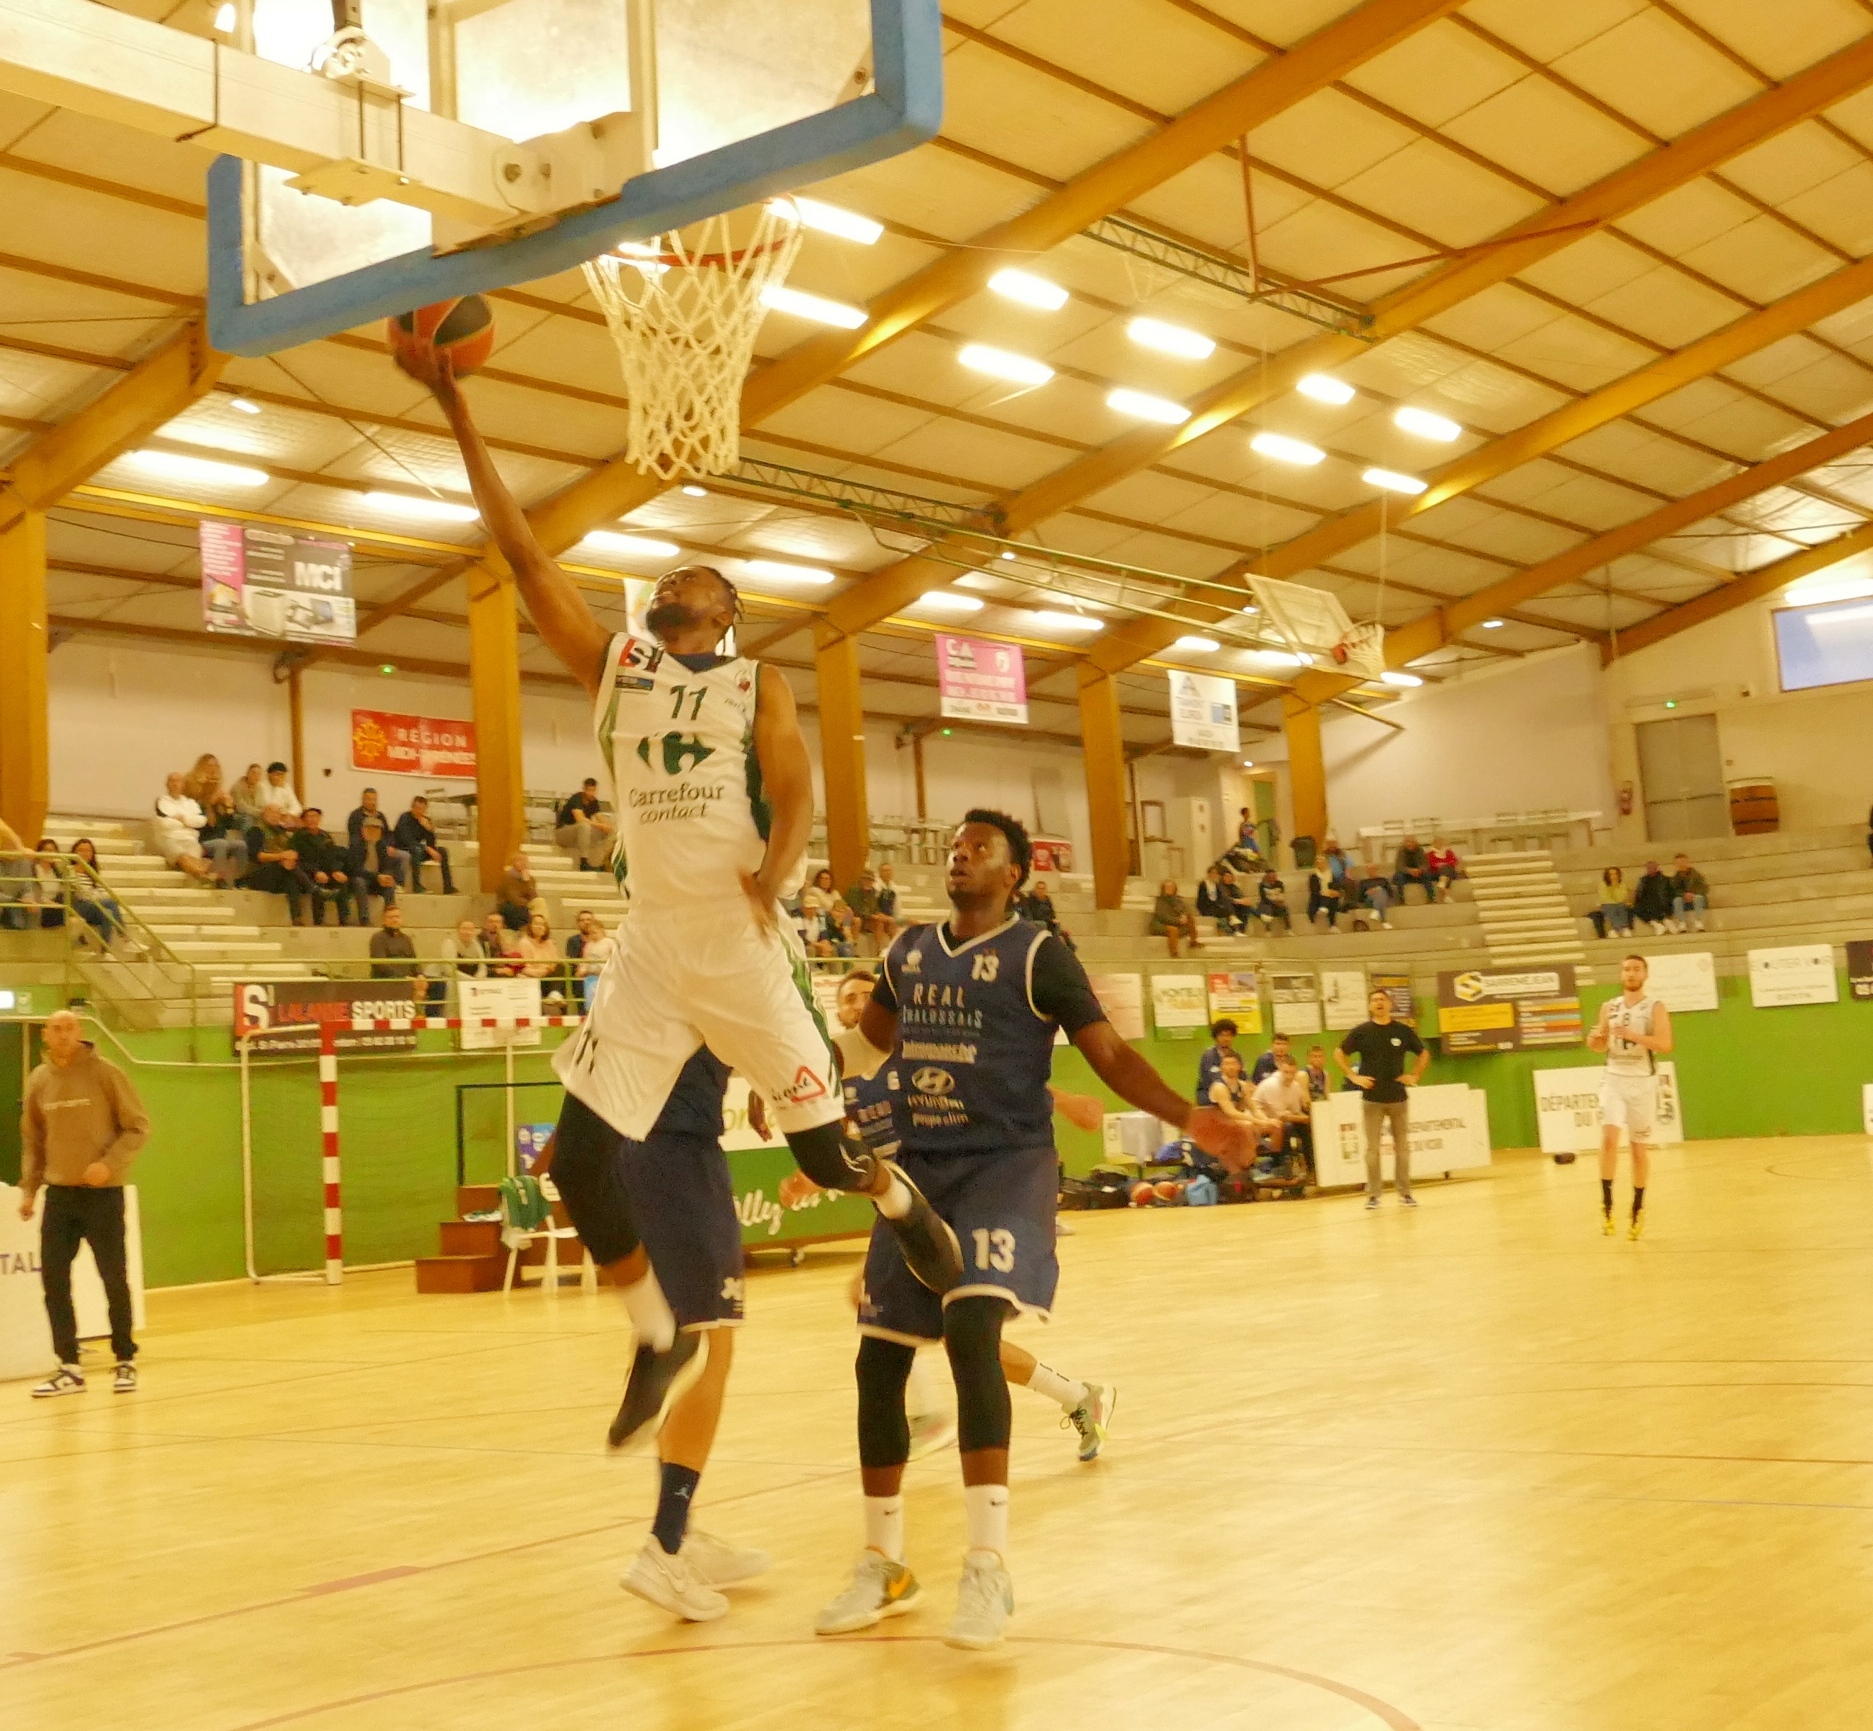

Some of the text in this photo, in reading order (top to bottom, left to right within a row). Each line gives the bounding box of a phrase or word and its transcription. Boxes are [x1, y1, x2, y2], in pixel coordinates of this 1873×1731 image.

[669, 684, 709, 721] 11
[629, 782, 725, 808] Carrefour
[640, 802, 708, 825] contact
[971, 953, 1000, 982] 13
[913, 982, 965, 1008] REAL
[351, 999, 416, 1020] SPORTS
[971, 1227, 1015, 1273] 13
